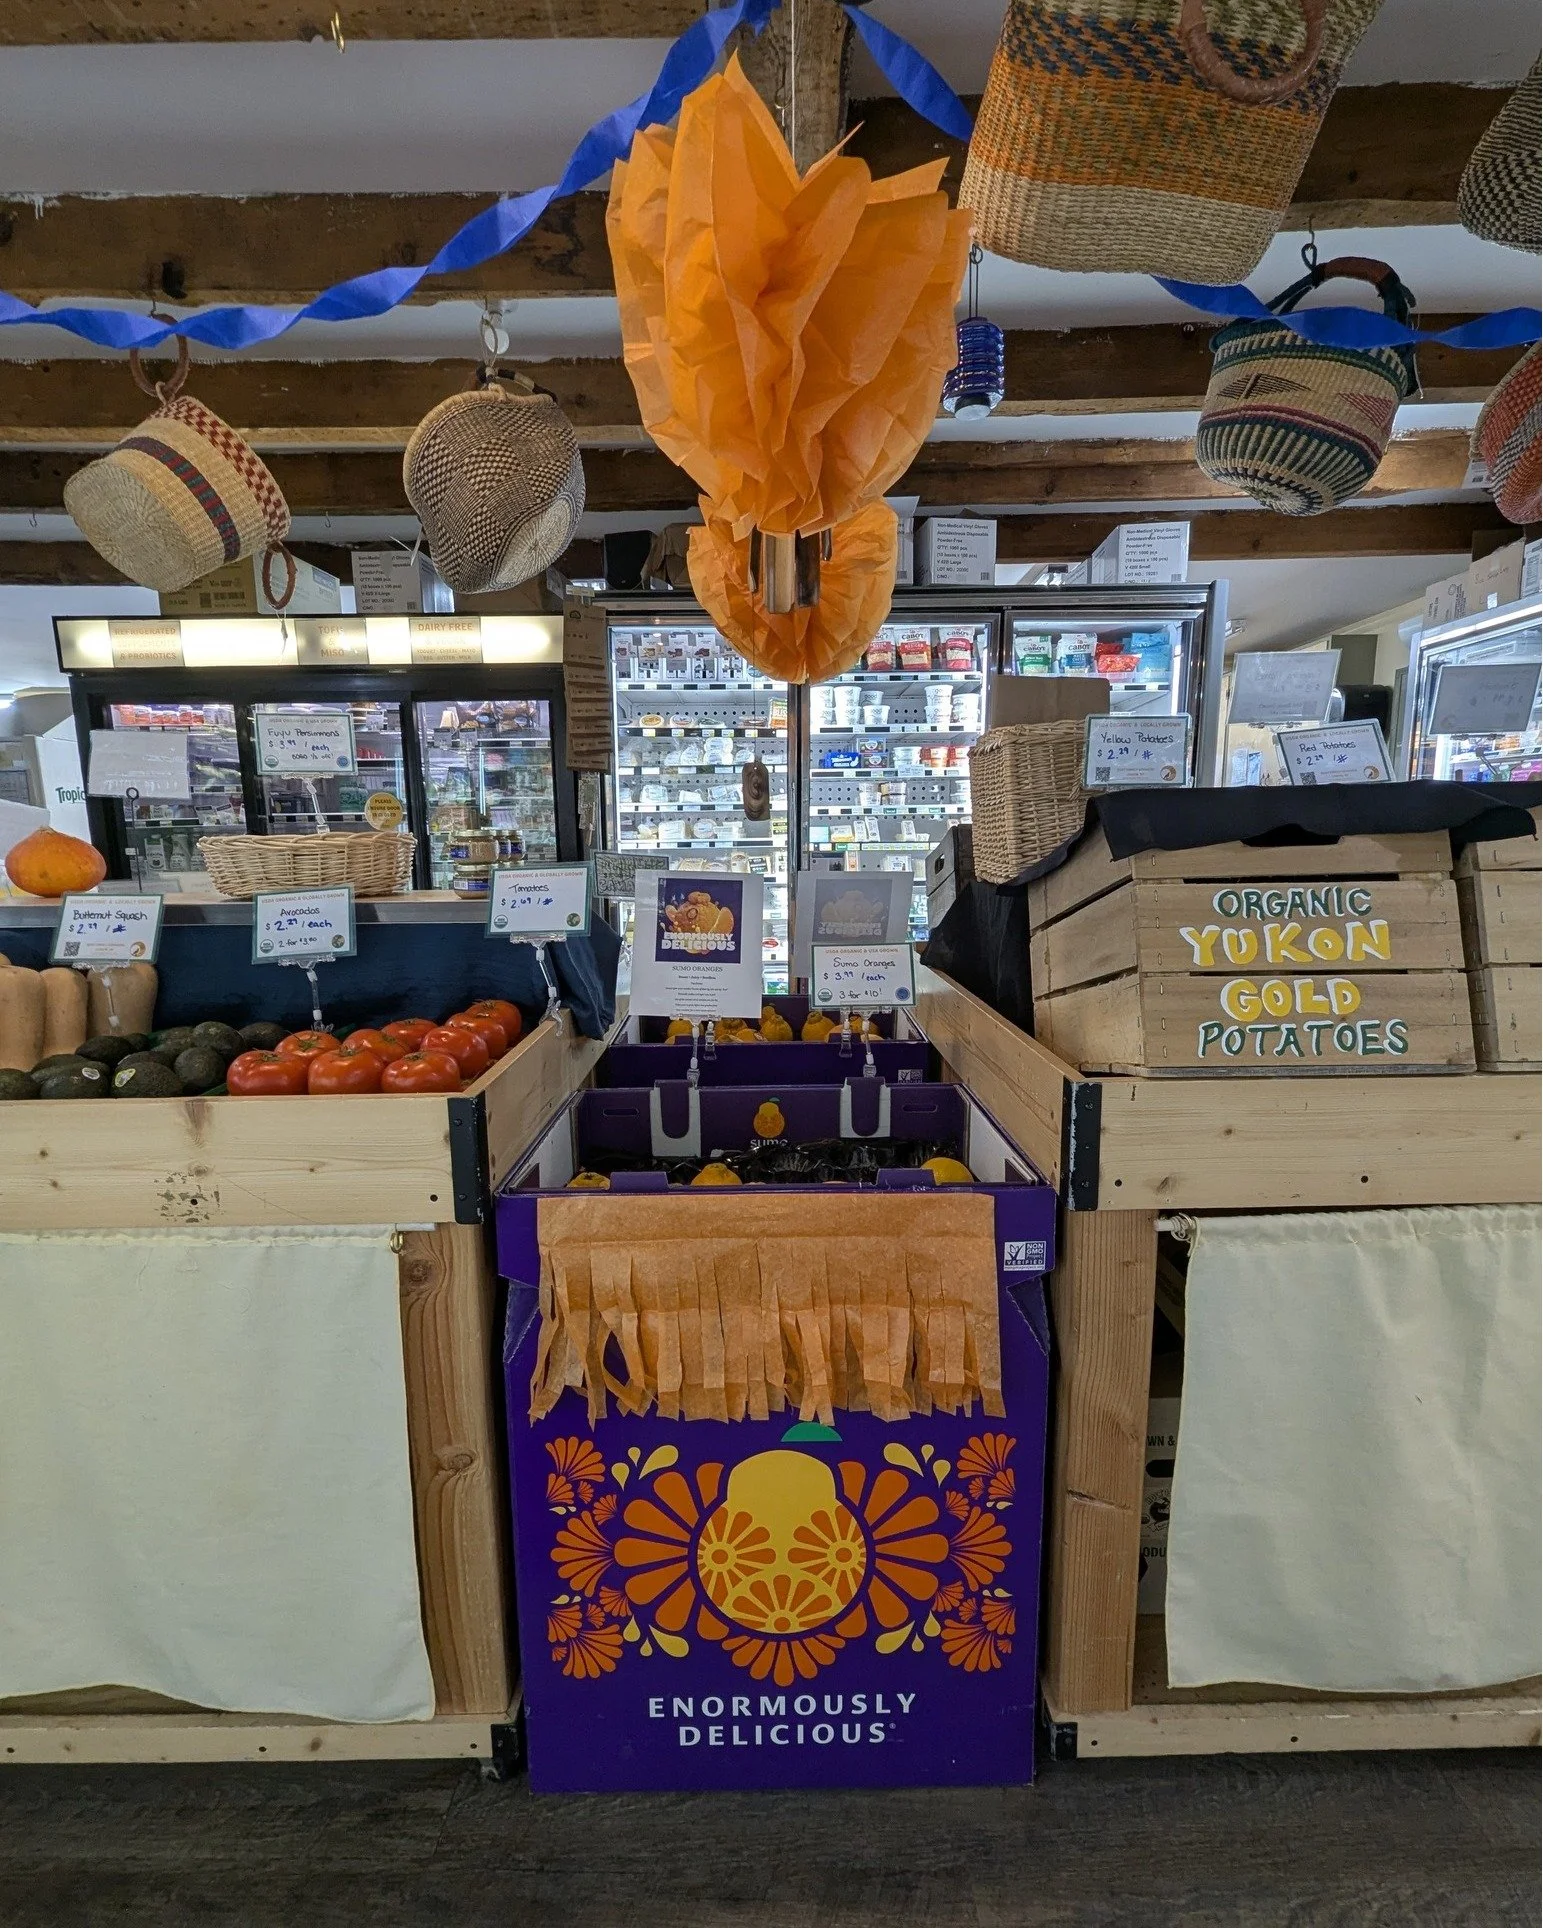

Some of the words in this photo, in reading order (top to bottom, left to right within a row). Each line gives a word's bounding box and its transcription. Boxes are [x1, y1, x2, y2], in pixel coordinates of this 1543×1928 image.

[114, 627, 176, 636] REFRIGERATED
[418, 623, 444, 632] DAIRY
[449, 622, 472, 630] FREE
[128, 652, 177, 660] PROBIOTICS
[321, 649, 344, 657] MISO
[268, 728, 291, 739] Fuyu
[295, 728, 339, 737] Persimmons
[1101, 732, 1131, 744] Yellow
[1135, 732, 1174, 743] Potatoes
[269, 740, 274, 748] $
[1299, 744, 1316, 752] Red
[1320, 741, 1356, 749] Potatoes
[1097, 750, 1102, 758] $
[508, 884, 549, 893] Tomatoes
[501, 898, 506, 906] $
[511, 897, 531, 909] 2.69
[1212, 886, 1372, 920] ORGANIC
[73, 910, 112, 920] Butternut
[115, 910, 148, 921] Squash
[280, 907, 320, 917] Avocados
[307, 920, 332, 929] each
[664, 932, 733, 940] ENORMOUSLY
[661, 940, 736, 951] DELICIOUS
[1180, 920, 1392, 966] YUKON
[833, 957, 858, 967] Sumo
[864, 959, 896, 969] Oranges
[824, 972, 828, 980] $
[835, 971, 854, 980] 3.99
[839, 991, 845, 999] 3
[848, 990, 861, 999] for
[1220, 978, 1361, 1022] GOLD
[1198, 1019, 1409, 1058] POTATOES
[649, 1693, 916, 1718] ENORMOUSLY
[679, 1722, 885, 1746] DELICIOUS
